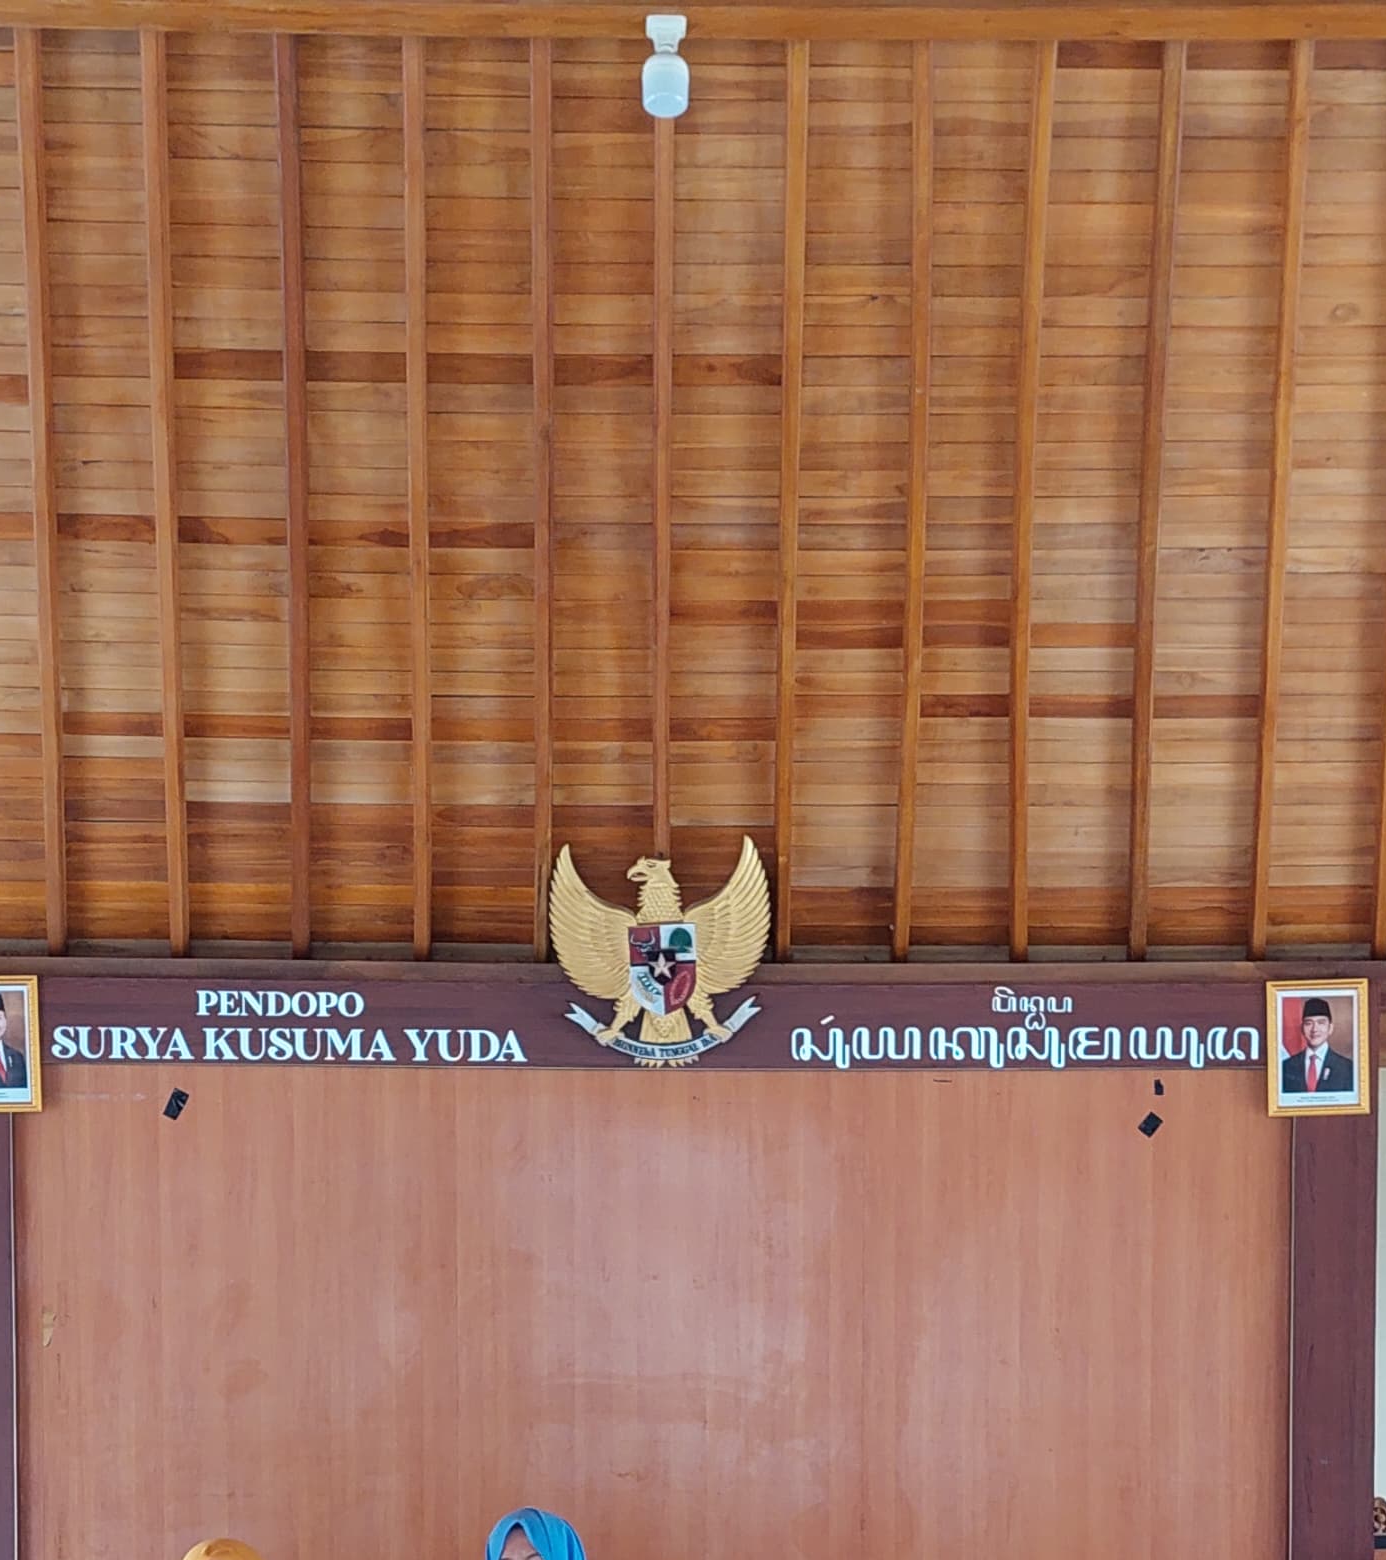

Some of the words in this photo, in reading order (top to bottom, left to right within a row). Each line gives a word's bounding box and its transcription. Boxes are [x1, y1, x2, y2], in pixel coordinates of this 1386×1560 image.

[196, 989, 365, 1018] PENDOPO
[50, 1025, 197, 1061] SURYA
[200, 1026, 398, 1062] KUSUMA
[401, 1028, 530, 1064] YUDA
